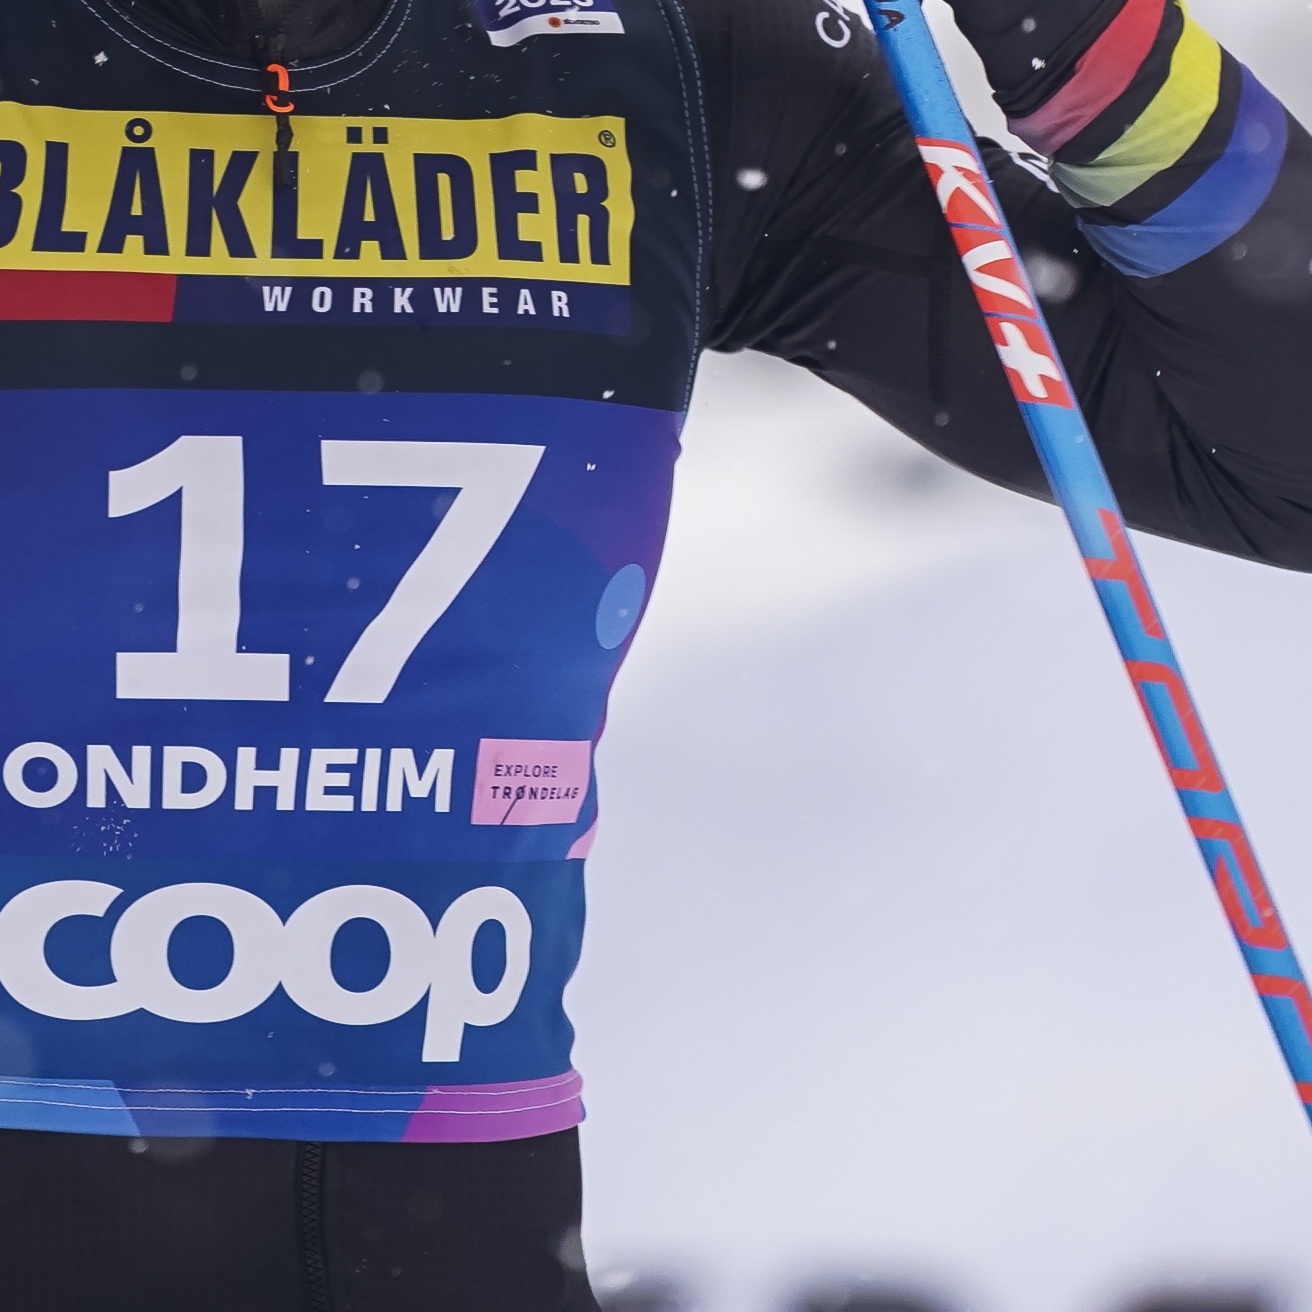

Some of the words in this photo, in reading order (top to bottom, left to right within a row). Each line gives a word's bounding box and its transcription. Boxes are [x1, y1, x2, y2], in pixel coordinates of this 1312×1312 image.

[262, 284, 571, 318] WORKWEAR
[107, 434, 546, 704] 17
[494, 764, 558, 778] EXPLORE
